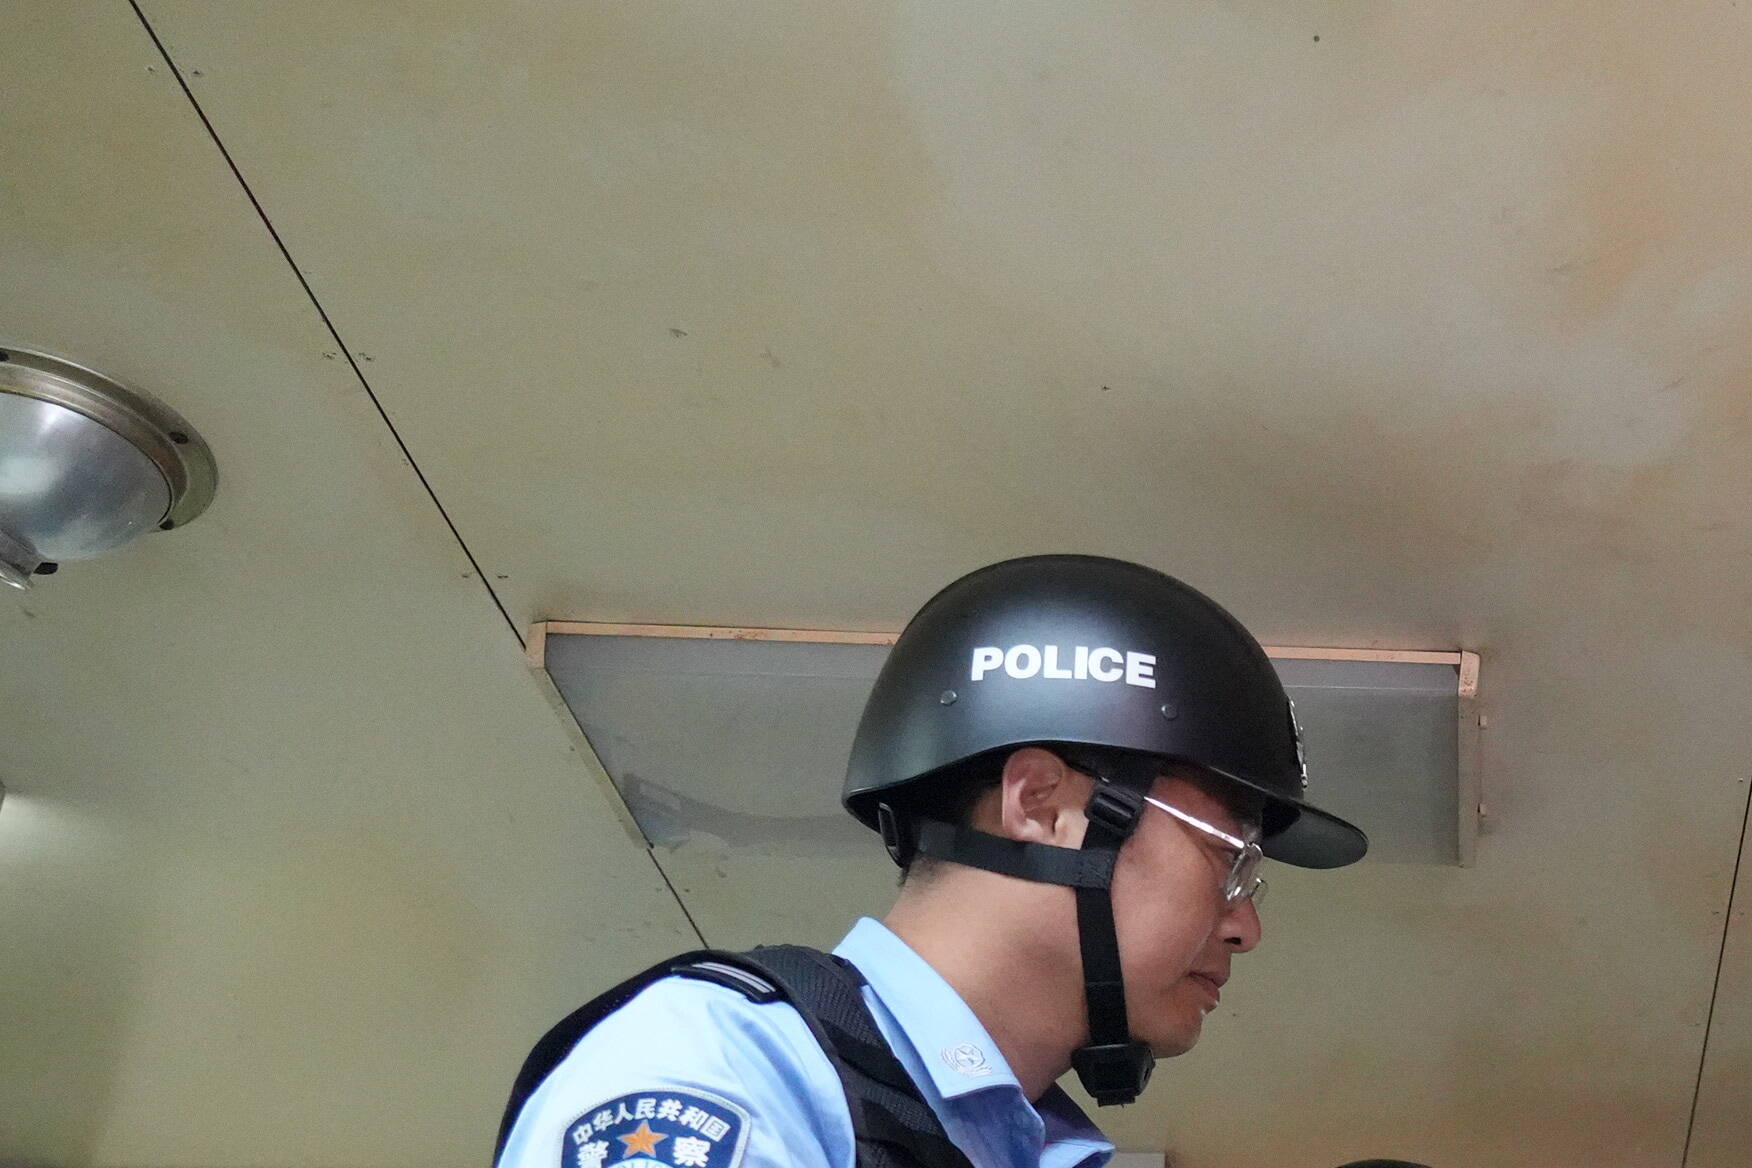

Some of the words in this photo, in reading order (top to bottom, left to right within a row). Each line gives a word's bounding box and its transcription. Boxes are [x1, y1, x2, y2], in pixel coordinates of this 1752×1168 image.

[971, 644, 1156, 689] POLICE
[572, 1098, 731, 1143] 中华人民共和国
